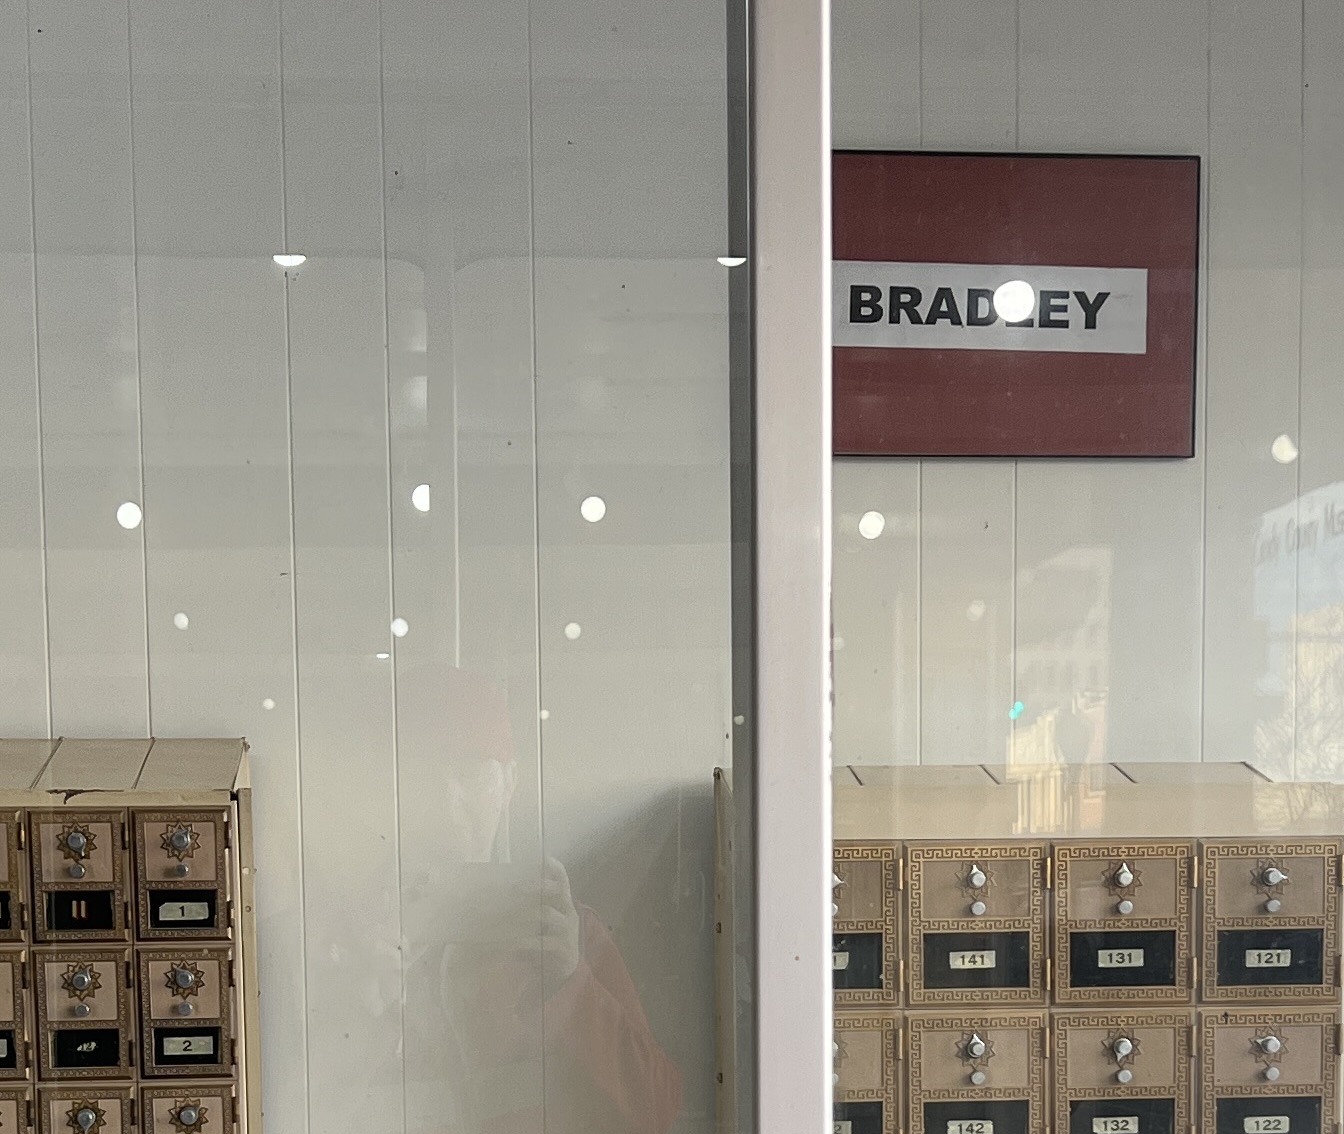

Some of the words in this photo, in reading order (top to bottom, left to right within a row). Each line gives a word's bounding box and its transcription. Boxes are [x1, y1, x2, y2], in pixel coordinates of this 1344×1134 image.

[179, 906, 186, 917] 1
[959, 954, 986, 966] 141
[1107, 952, 1133, 964] 131
[1256, 953, 1282, 964] 121
[182, 1040, 193, 1052] 2
[957, 1123, 985, 1134] 142
[1102, 1120, 1130, 1132] 132
[1254, 1120, 1282, 1131] 122
